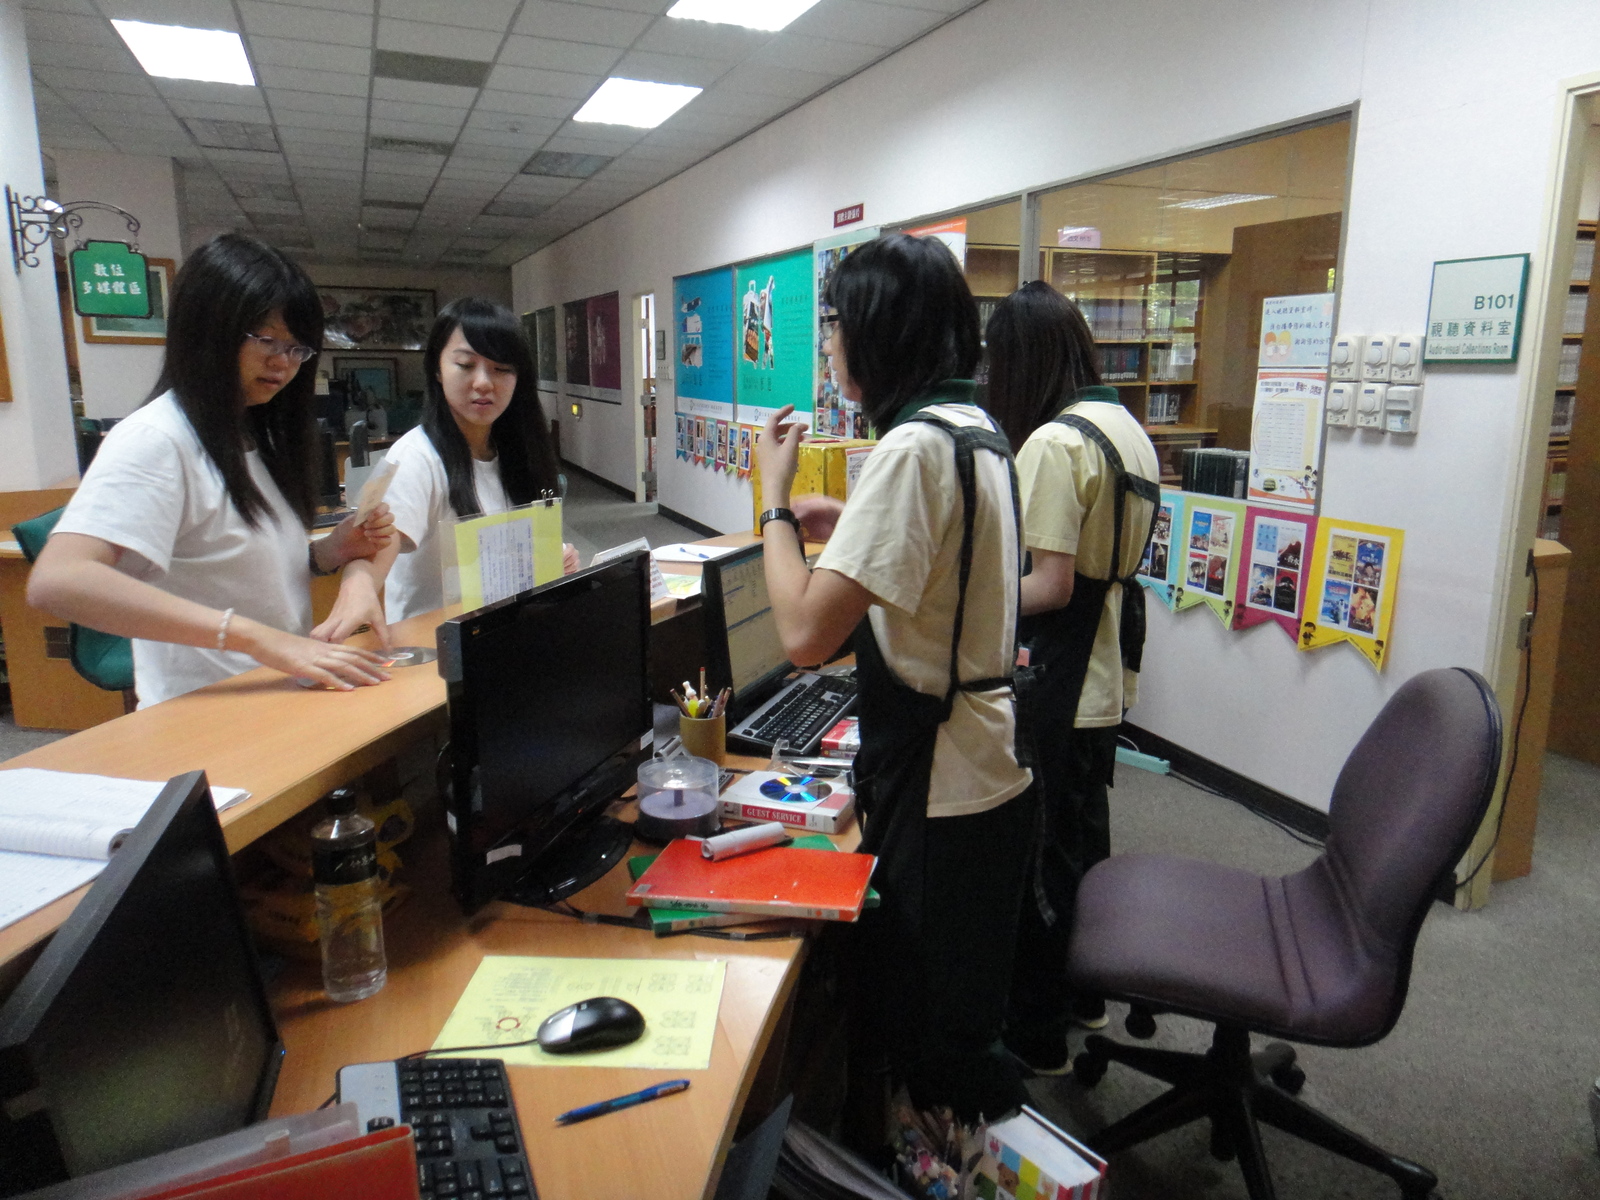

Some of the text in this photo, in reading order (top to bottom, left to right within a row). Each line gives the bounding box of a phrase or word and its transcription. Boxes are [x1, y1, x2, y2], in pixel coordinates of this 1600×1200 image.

[1474, 294, 1515, 310] B101
[1431, 320, 1512, 338] 視聽資料室
[746, 807, 802, 823] GUEST SERVICE
